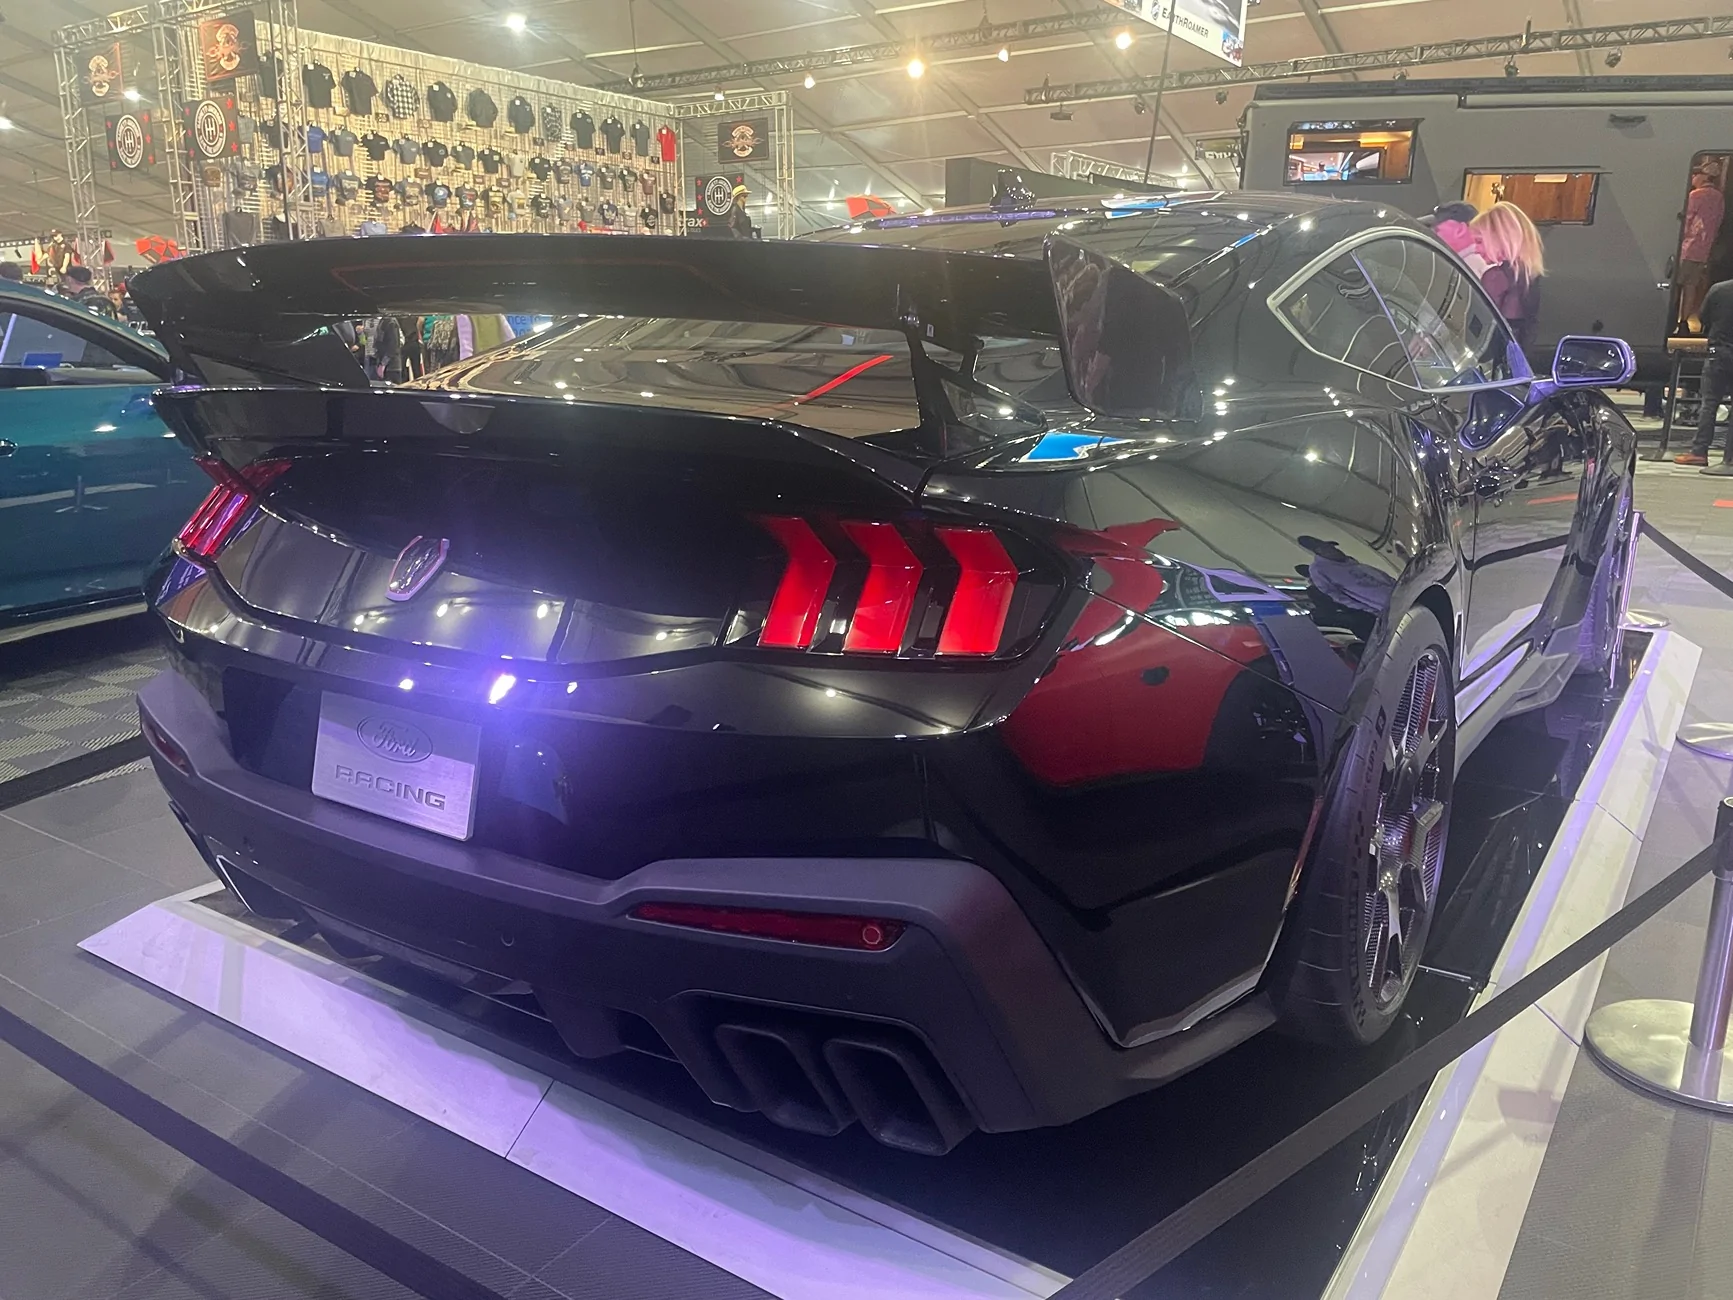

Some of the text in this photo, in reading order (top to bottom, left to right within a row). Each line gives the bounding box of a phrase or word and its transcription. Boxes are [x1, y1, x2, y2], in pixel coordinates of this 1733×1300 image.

[1162, 7, 1208, 38] EATHROAMER
[373, 721, 418, 757] Ford
[336, 765, 446, 810] RACING
